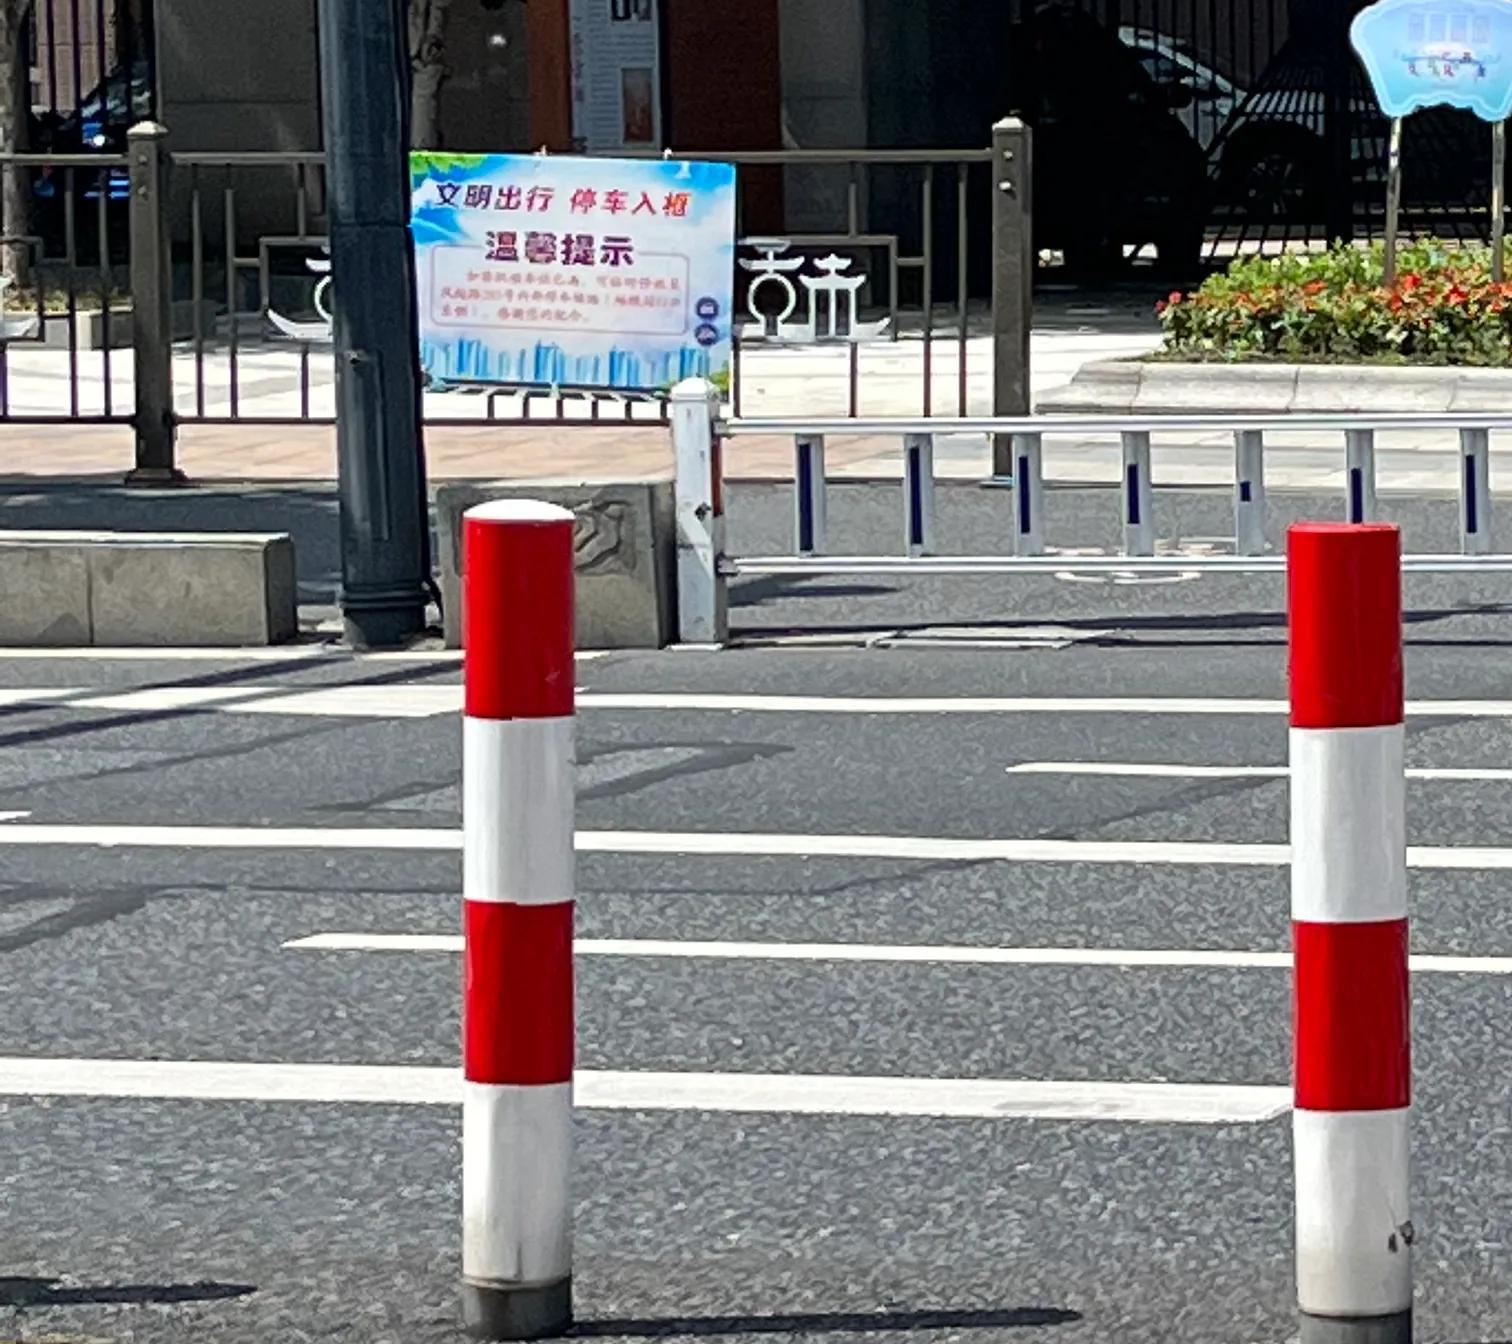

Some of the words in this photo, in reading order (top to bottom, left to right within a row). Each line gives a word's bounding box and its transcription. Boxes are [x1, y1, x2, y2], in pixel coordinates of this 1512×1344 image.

[436, 182, 556, 212] 文明出行
[485, 230, 635, 266] 温馨提示
